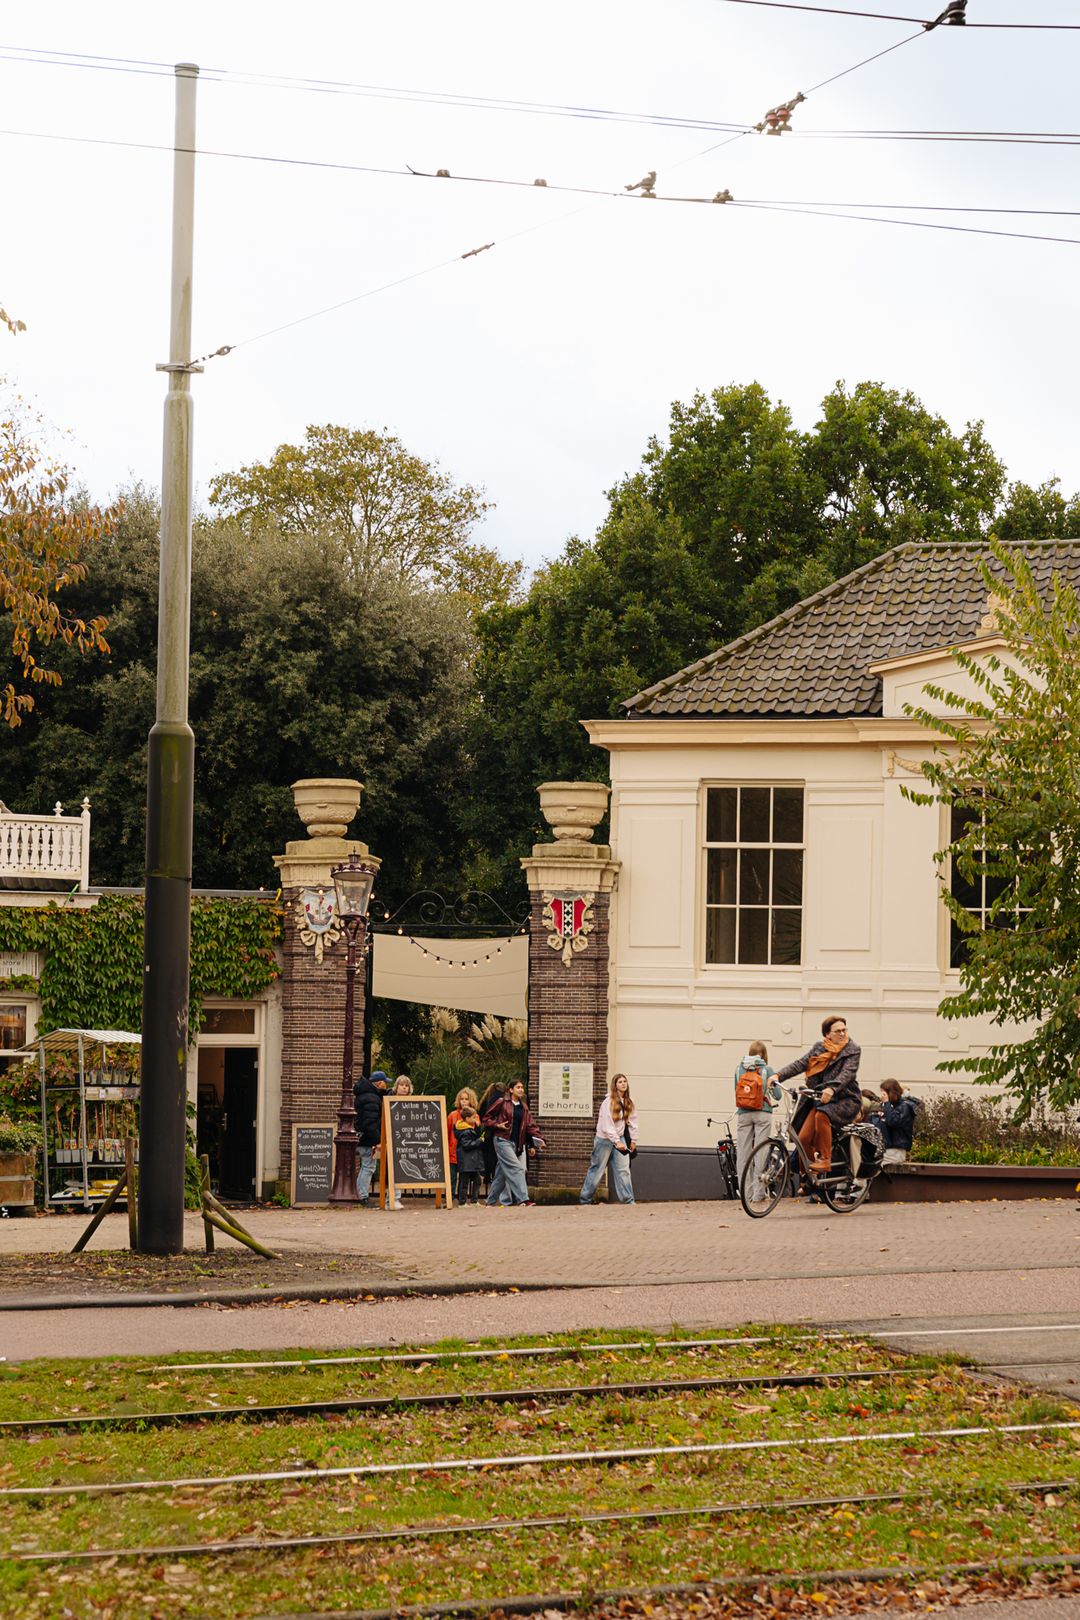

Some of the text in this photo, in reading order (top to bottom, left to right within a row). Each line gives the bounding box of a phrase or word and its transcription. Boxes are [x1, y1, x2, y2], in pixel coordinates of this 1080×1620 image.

[394, 1111, 437, 1120] de hortus
[415, 1132, 427, 1140] open
